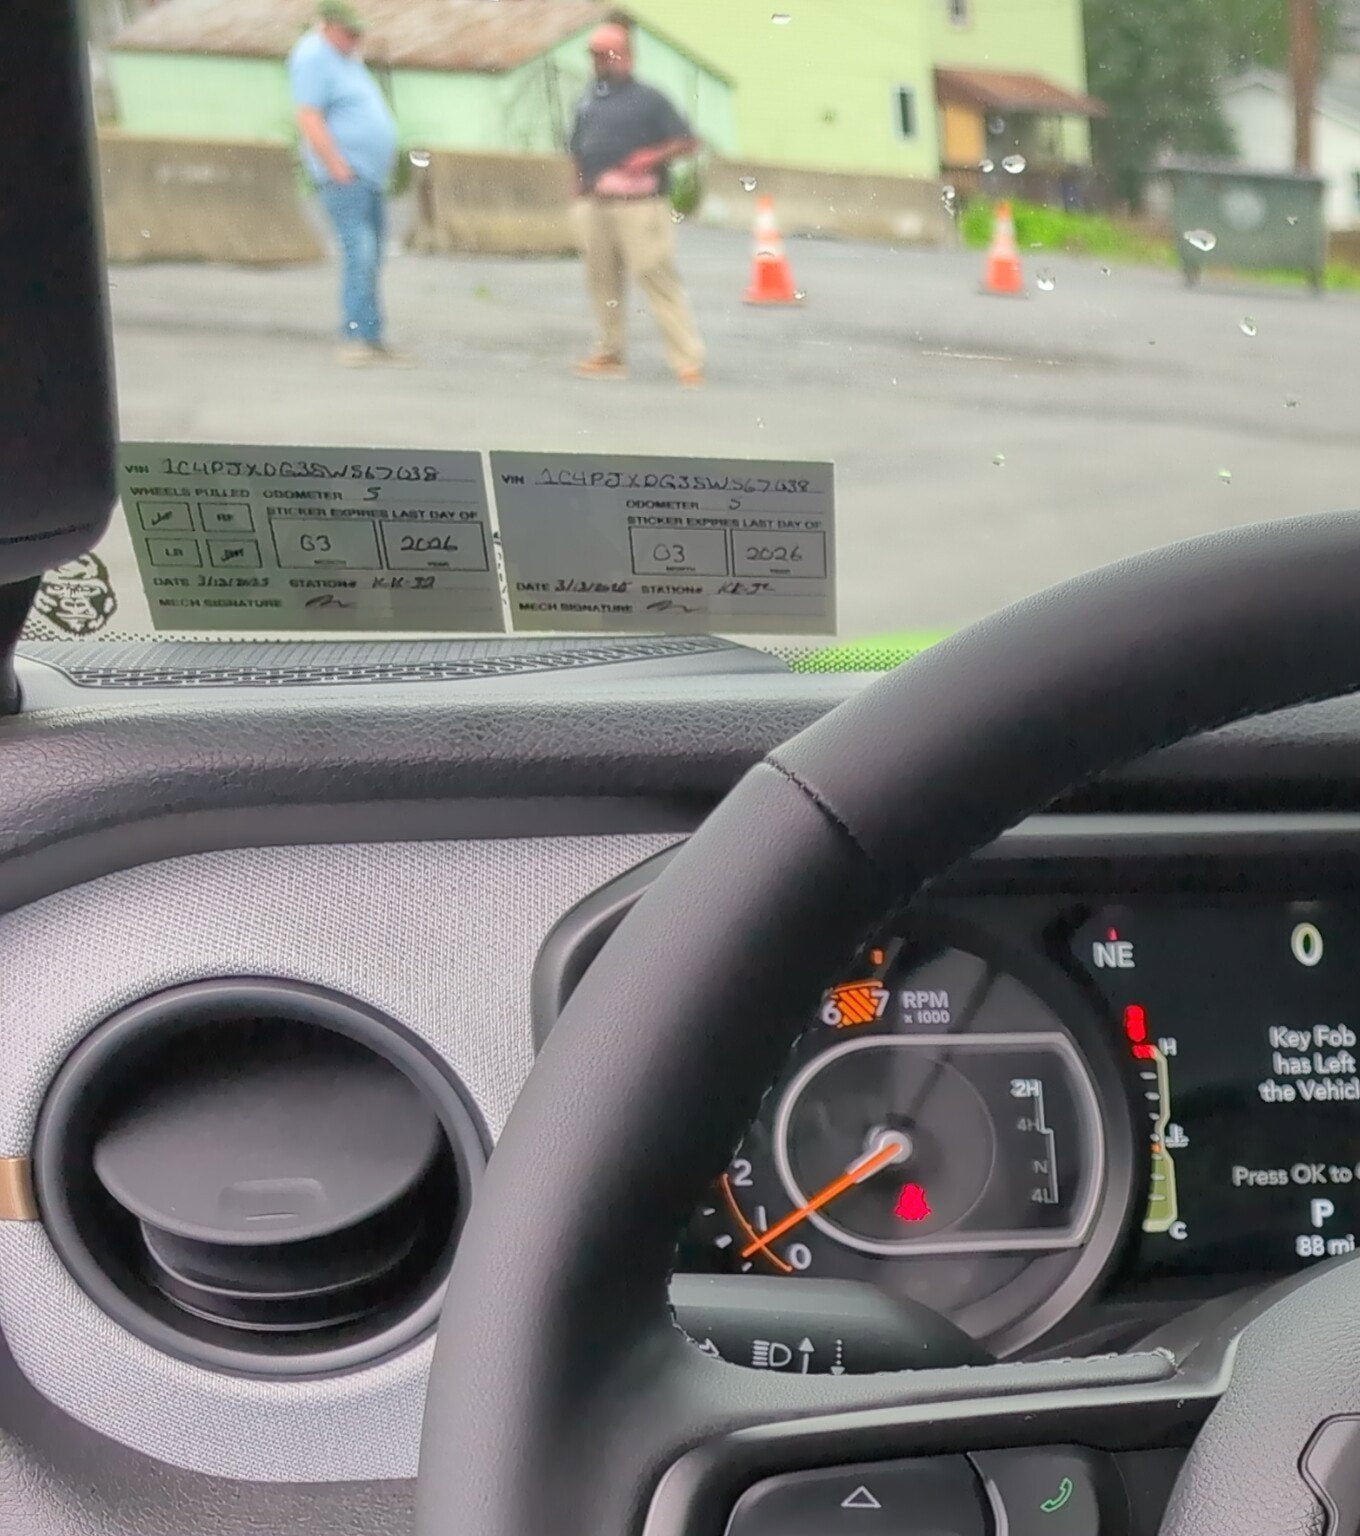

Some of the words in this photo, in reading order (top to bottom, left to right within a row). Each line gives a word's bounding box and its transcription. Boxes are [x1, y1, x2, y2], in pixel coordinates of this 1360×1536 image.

[124, 464, 149, 474] VIN
[502, 474, 525, 484] VIN
[130, 487, 191, 498] WHEELS
[195, 487, 250, 498] PULLED
[263, 490, 343, 501] ODOMETER
[267, 506, 326, 517] STICKER
[330, 508, 389, 519] EXPIRES
[392, 510, 425, 519] LAST
[430, 510, 455, 519] DAY
[459, 511, 478, 519] OF
[626, 500, 699, 511] ODOMETER
[627, 515, 683, 526] STICKER
[686, 517, 740, 527] EXPIRES
[743, 519, 775, 528] LAST
[778, 520, 801, 529] DAY
[804, 521, 822, 529] OF
[400, 535, 459, 552] 2026
[652, 543, 686, 563] 03
[746, 545, 803, 562] 2026
[153, 577, 189, 587] DATE
[516, 582, 549, 593] DATE
[159, 598, 200, 608] MECH
[203, 599, 282, 609] SIGNATURE
[519, 602, 558, 612] MECH
[560, 603, 633, 614] SIGNATURE
[1291, 922, 1324, 967] 0
[1092, 941, 1135, 968] NE
[872, 990, 891, 1018] 7
[902, 990, 950, 1009] RPM
[821, 1003, 842, 1027] 6
[916, 1009, 951, 1025] 1000
[1158, 1038, 1178, 1056] H
[1269, 1025, 1311, 1053] Key
[1315, 1023, 1357, 1048] Fob
[1273, 1051, 1312, 1076] has
[1315, 1050, 1357, 1075] Left
[1258, 1080, 1296, 1102] the
[733, 1159, 754, 1187] 2
[1232, 1166, 1289, 1187] Press
[1292, 1164, 1328, 1184] OK
[1331, 1164, 1353, 1184] to
[1310, 1199, 1335, 1227] P
[1169, 1222, 1188, 1240] C
[1296, 1235, 1325, 1258] 88
[1327, 1234, 1356, 1255] mi
[789, 1243, 813, 1270] 0
